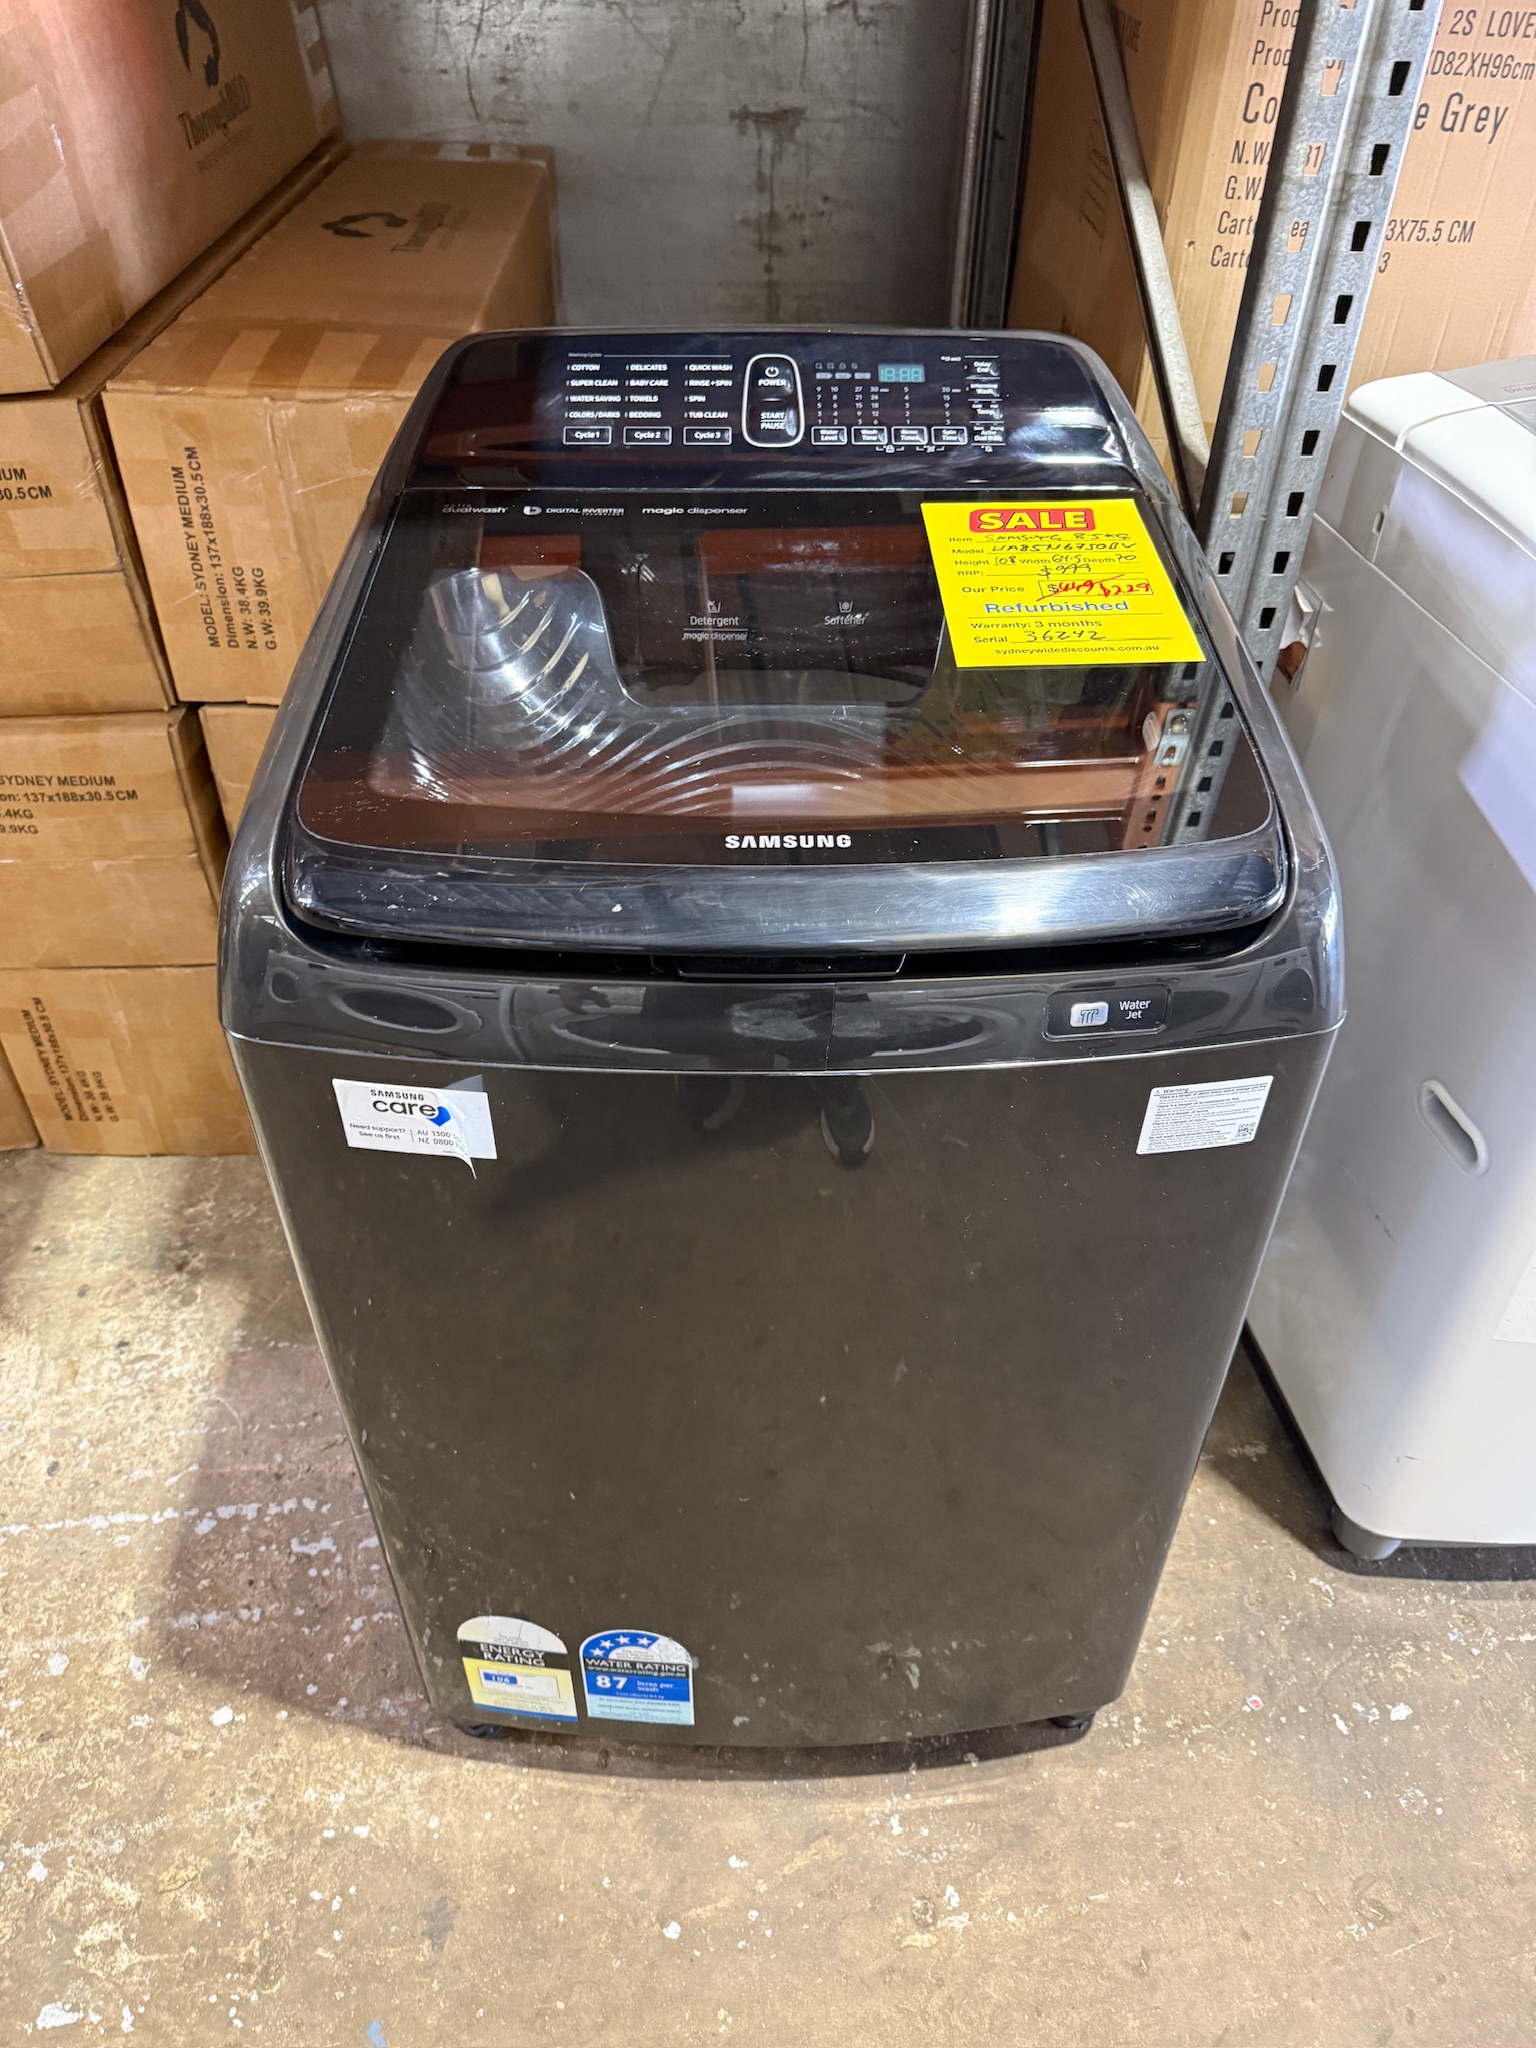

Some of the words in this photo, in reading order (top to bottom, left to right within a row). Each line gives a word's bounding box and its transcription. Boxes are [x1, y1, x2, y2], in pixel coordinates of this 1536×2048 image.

[1449, 10, 1476, 36] 2S
[1486, 11, 1536, 38] LOVE
[1440, 92, 1509, 144] Grey
[1447, 220, 1476, 244] CM
[634, 432, 654, 440] Cycle
[694, 432, 714, 440] Cycle
[171, 466, 195, 528] MEDIUM
[642, 507, 684, 515] magic
[687, 507, 748, 515] dispenser
[977, 510, 1088, 530] SALE
[185, 531, 209, 592] SYDNEY
[213, 575, 240, 649] Dimension:
[985, 601, 1129, 614] Refurbished
[197, 593, 220, 648] MODEL:
[690, 616, 739, 628] Detergent
[824, 615, 865, 625] Softener
[711, 631, 747, 642] dispenser
[995, 645, 1159, 655] sydneywidediscounts.com.au
[57, 775, 116, 787] MEDIUM
[725, 835, 852, 849] SAMSUNG
[1119, 1000, 1151, 1011] Water
[1125, 1011, 1142, 1019] Jet
[371, 1089, 424, 1101] SAMSUNG
[373, 1100, 436, 1117] care
[480, 1643, 545, 1658] ENERGY
[483, 1652, 545, 1667] RATING
[585, 1658, 632, 1669] WATER
[636, 1662, 687, 1672] RATING
[596, 1675, 627, 1689] 87
